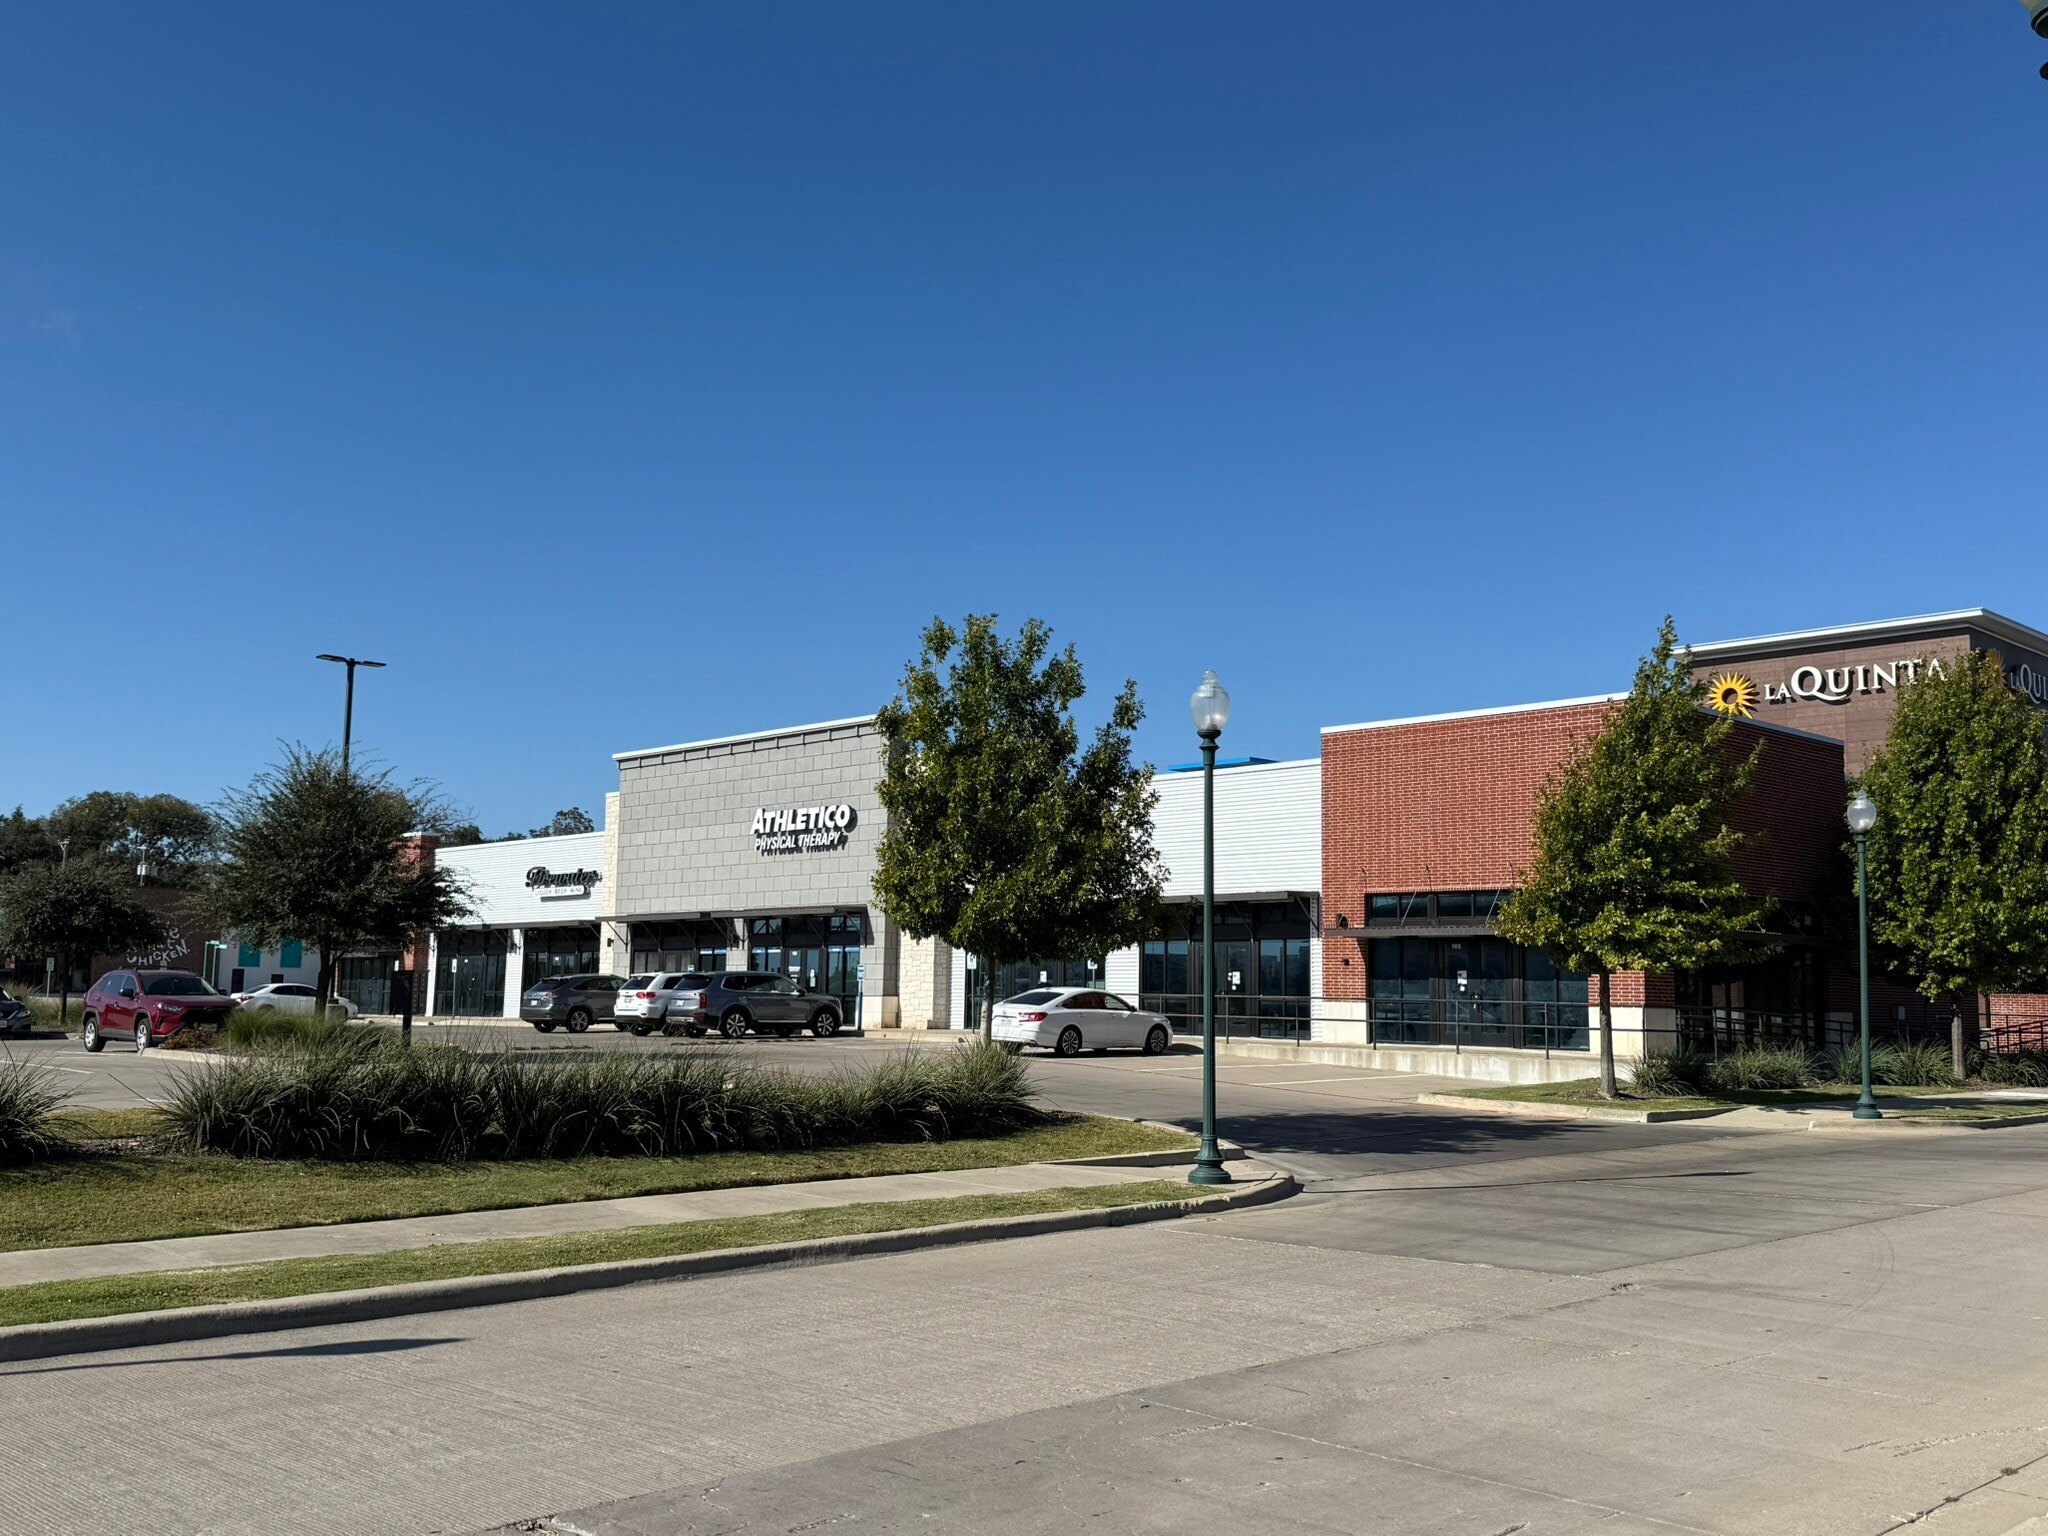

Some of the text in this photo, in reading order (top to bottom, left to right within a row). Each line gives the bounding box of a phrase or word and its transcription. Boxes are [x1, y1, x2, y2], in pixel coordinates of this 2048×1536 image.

[1764, 657, 1948, 702] LA QUINTA
[751, 805, 850, 834] ATHLETICO
[755, 831, 840, 850] PHYSICAL THERAPY
